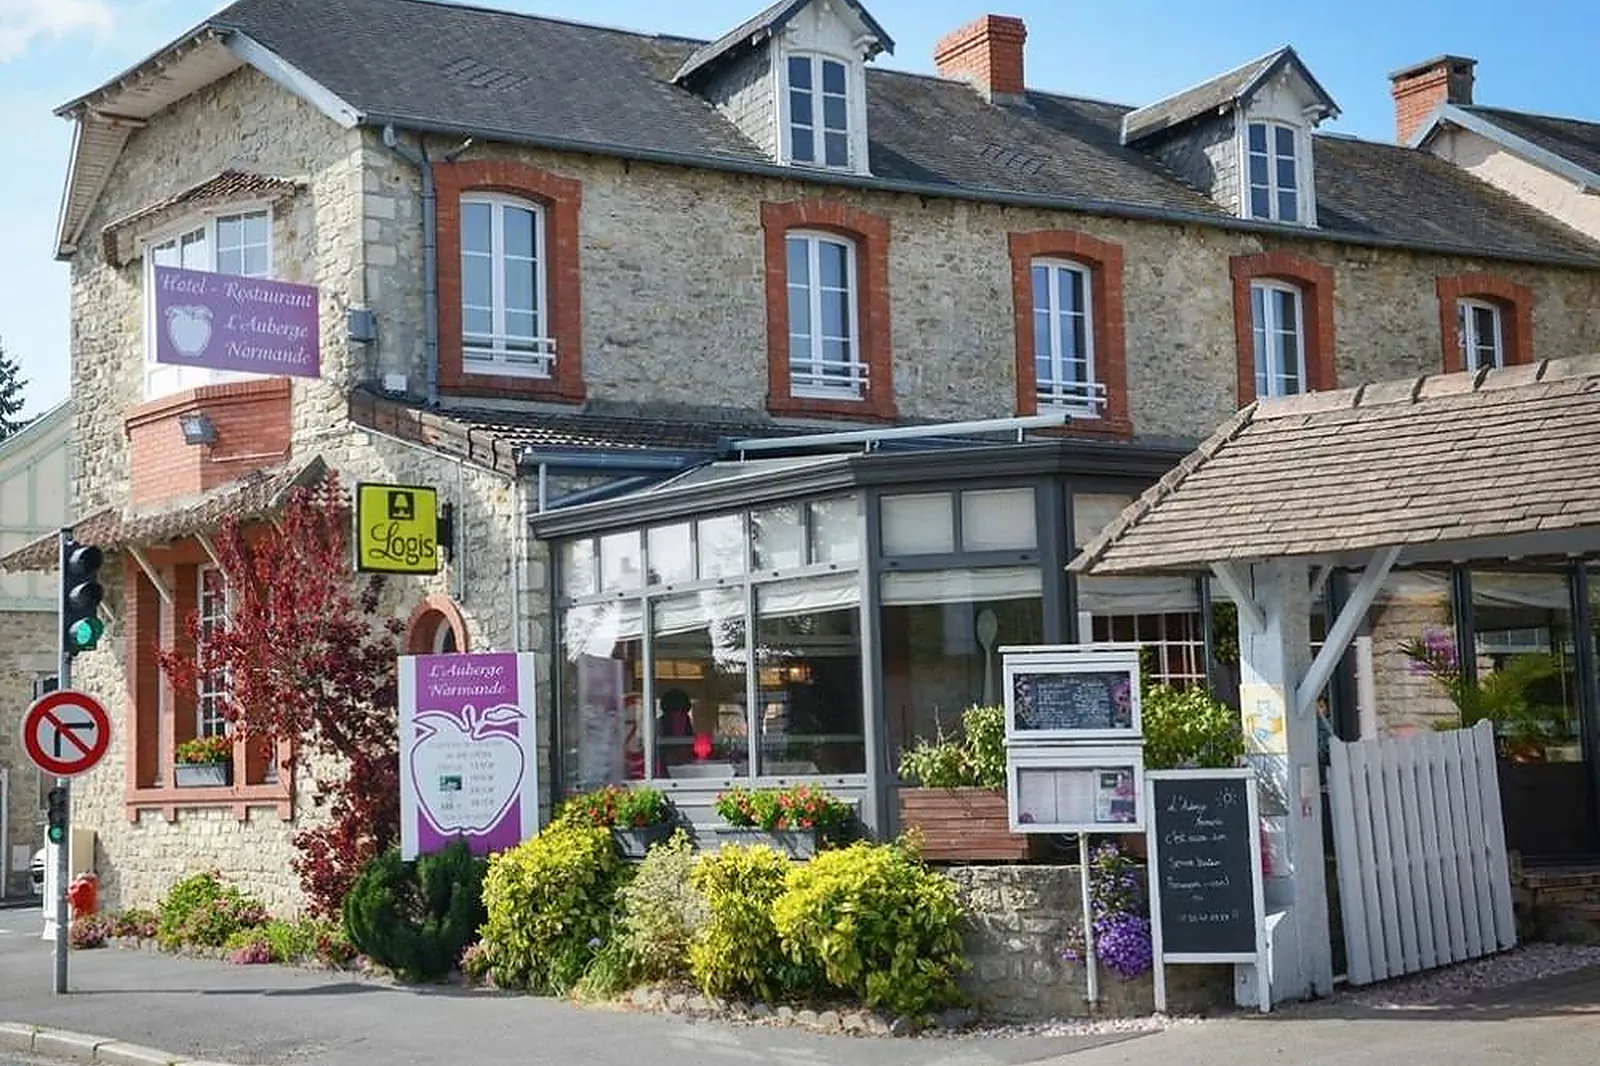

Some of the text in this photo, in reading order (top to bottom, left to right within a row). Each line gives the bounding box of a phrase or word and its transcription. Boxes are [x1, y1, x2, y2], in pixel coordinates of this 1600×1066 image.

[224, 282, 312, 308] Restaurant
[224, 314, 309, 341] L'Auberge
[225, 341, 312, 366] Normande
[369, 522, 434, 566] Logis
[430, 662, 504, 678] L'Auberge
[429, 680, 506, 697] Normande
